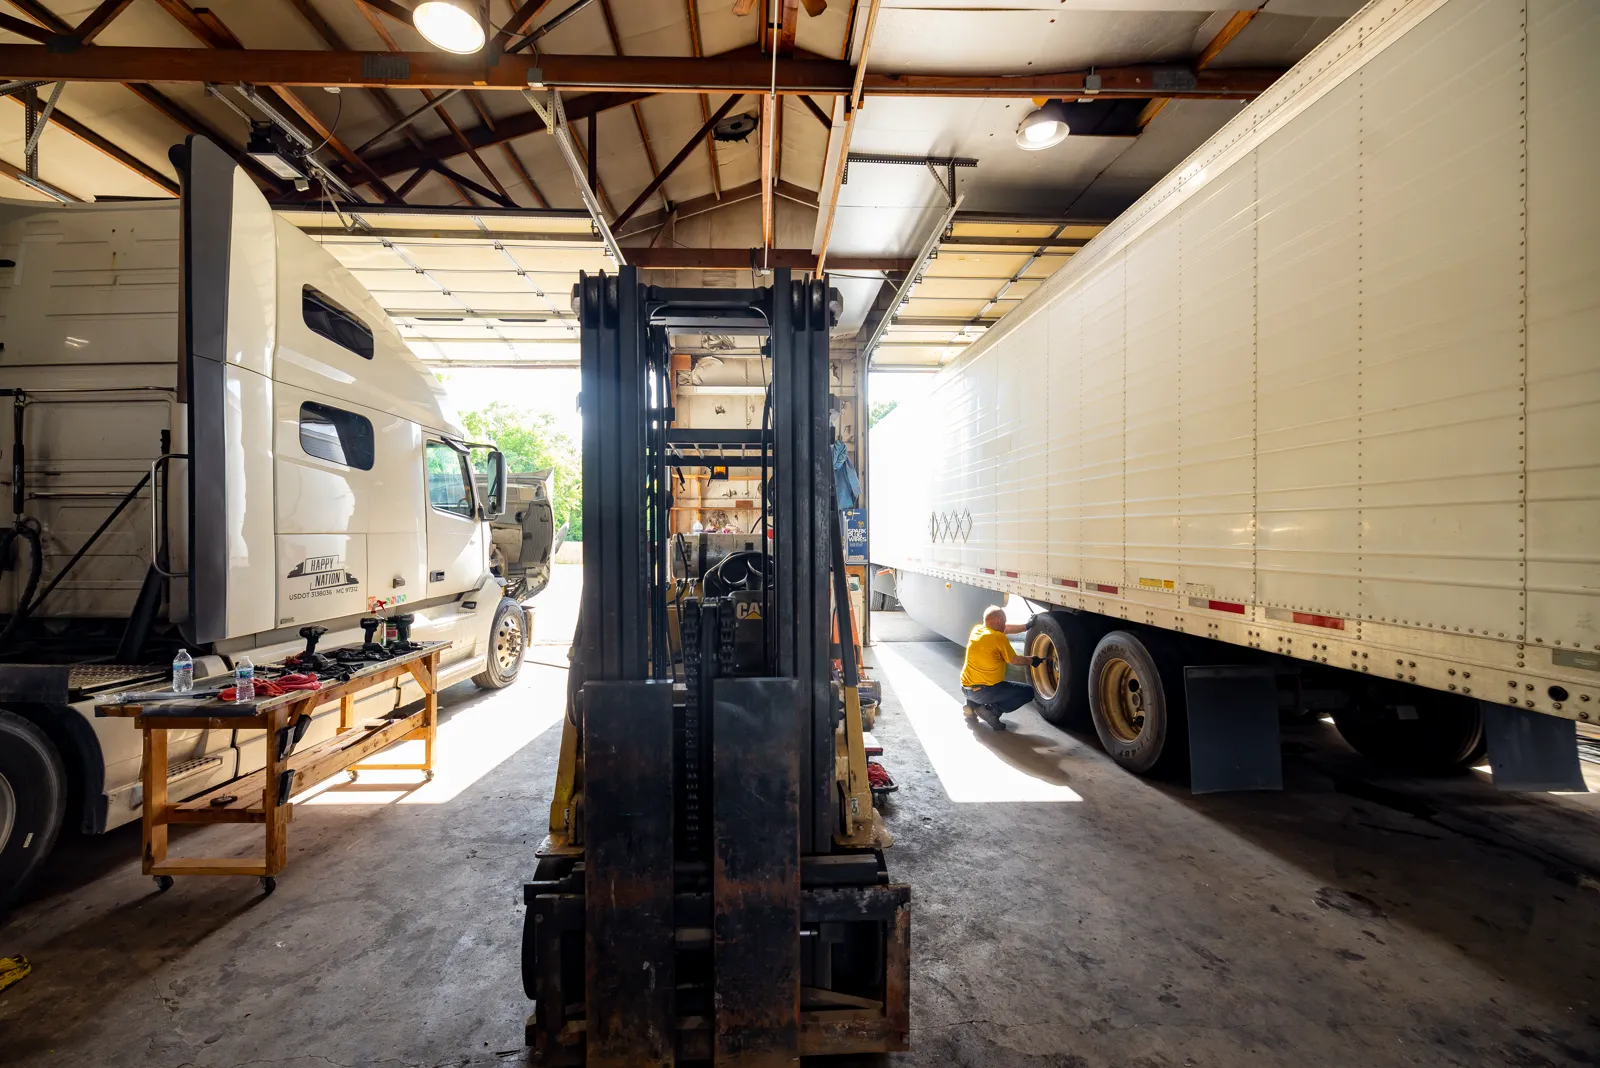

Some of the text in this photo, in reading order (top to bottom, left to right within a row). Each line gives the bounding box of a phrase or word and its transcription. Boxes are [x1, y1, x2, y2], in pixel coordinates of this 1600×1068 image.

[310, 558, 334, 571] HAPPY
[315, 572, 340, 587] NATION
[289, 592, 310, 600] USDOT
[736, 602, 763, 619] CA
